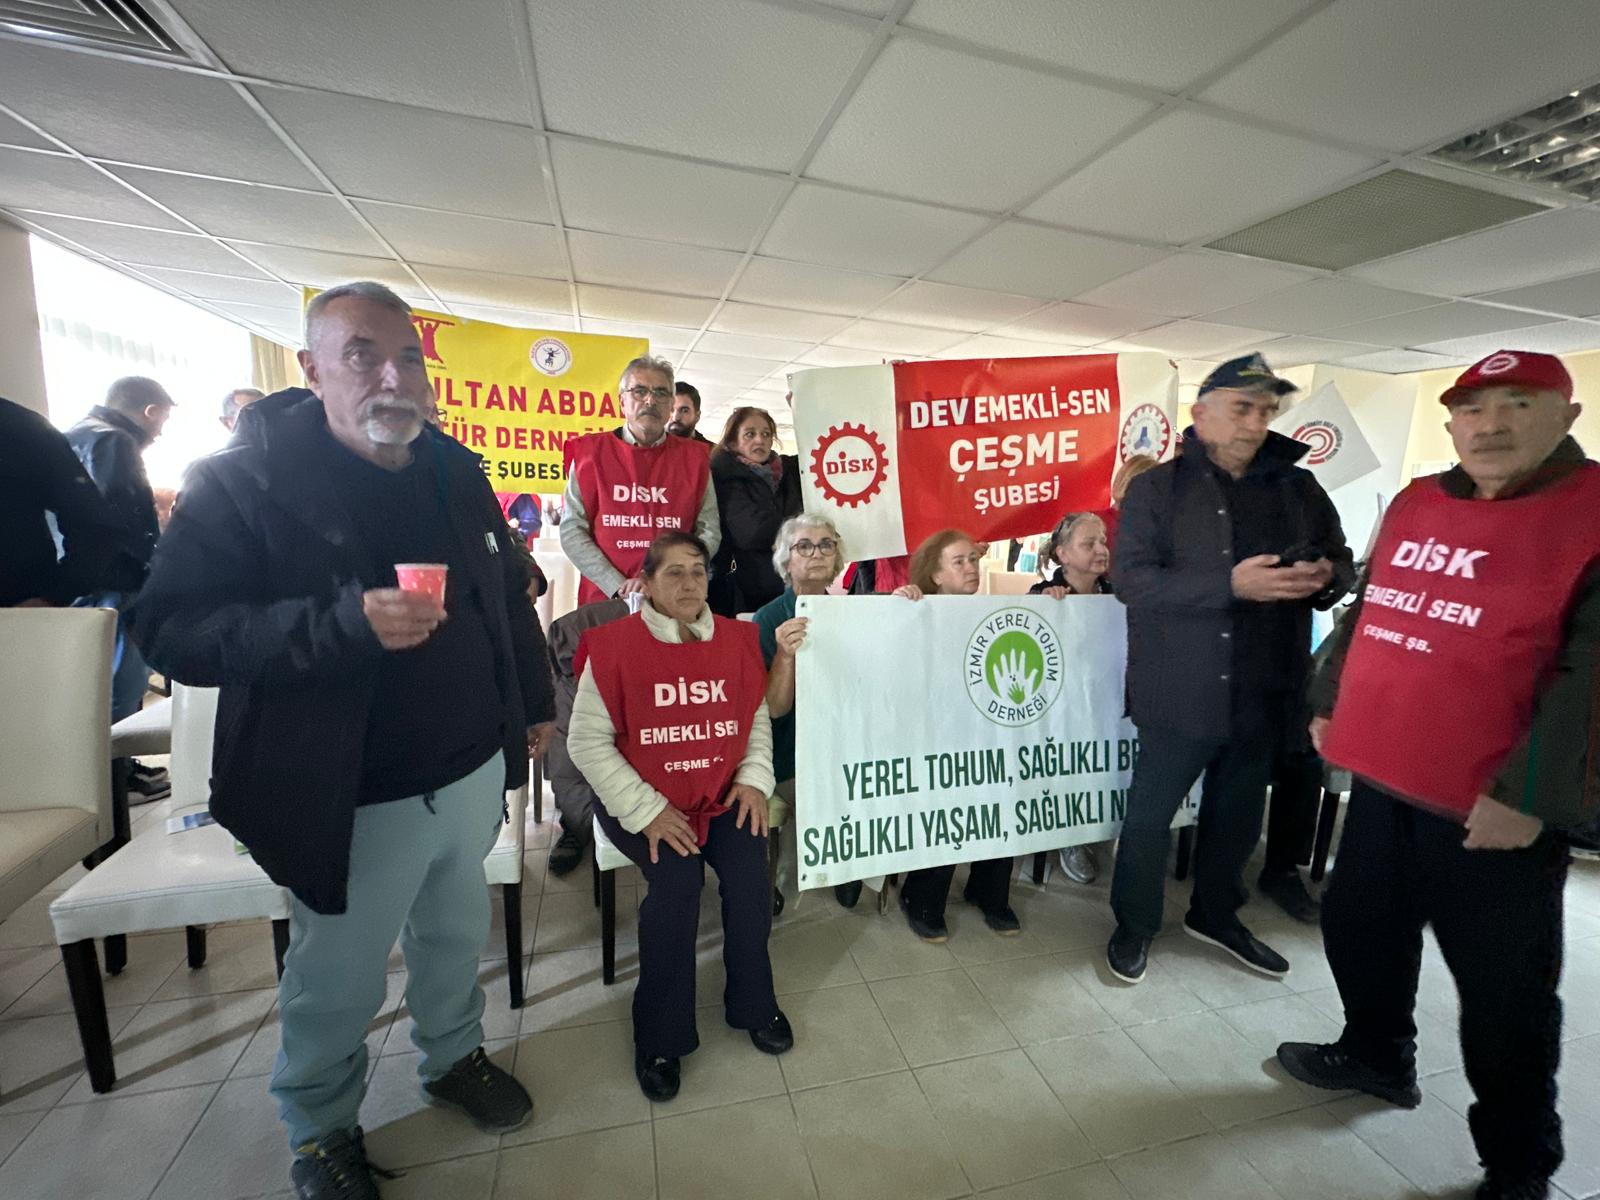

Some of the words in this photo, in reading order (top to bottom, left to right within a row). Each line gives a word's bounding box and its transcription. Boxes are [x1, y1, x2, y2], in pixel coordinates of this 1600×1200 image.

[910, 398, 969, 429] DEV
[974, 386, 1111, 424] EMEKLİ-SEN
[496, 426, 603, 452] DERN
[826, 451, 875, 475] DİSK
[950, 430, 1079, 482] ÇEŞME
[613, 482, 669, 503] DİSK
[974, 475, 1060, 515] ŞUBESİ
[602, 514, 652, 527] EMEKLİ
[655, 517, 681, 528] SEN
[616, 540, 650, 549] ÇEŞME
[1390, 537, 1490, 579] DİSK
[1364, 584, 1426, 614] EMEKLİ
[1427, 600, 1482, 628] SEN
[969, 635, 989, 686] İZMİR
[986, 613, 1031, 635] YEREL
[1034, 623, 1059, 681] TOHUM
[1363, 624, 1404, 644] ÇEŞME
[1405, 637, 1432, 653] ŞB.
[654, 677, 728, 707] DİSK
[987, 693, 1048, 721] DERNEĞİ
[640, 720, 711, 745] EMEKLİ
[664, 759, 710, 772] ÇEŞME
[843, 757, 919, 801] YEREL
[924, 748, 1013, 787] TOHUM,
[1018, 736, 1110, 781] SAĞLIKLI
[803, 814, 914, 867] SAĞLIKLI
[920, 803, 1009, 850] YAŞAM,
[1015, 789, 1104, 836] SAĞLIKLI
